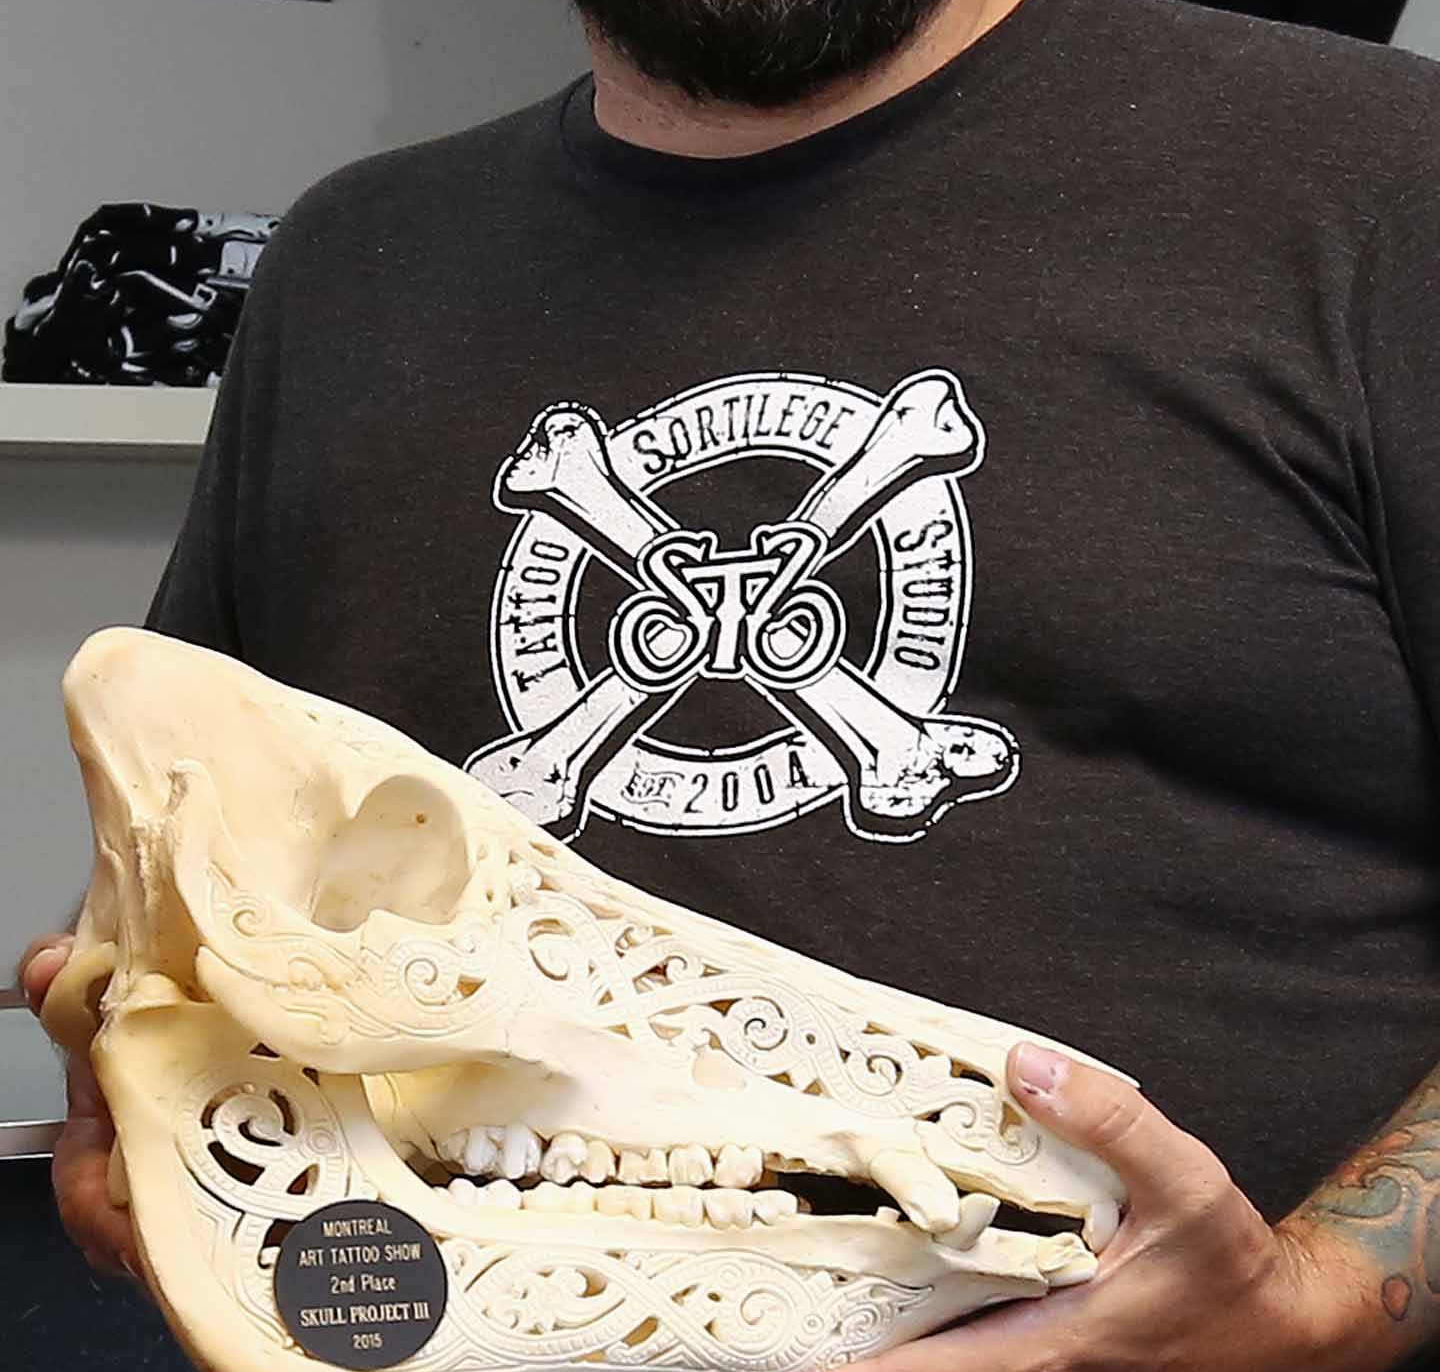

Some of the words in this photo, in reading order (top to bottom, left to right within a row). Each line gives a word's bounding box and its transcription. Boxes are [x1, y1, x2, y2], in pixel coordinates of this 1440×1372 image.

[632, 393, 857, 476] SORTILEGE
[893, 509, 955, 672] STUDIO
[512, 537, 570, 692] TATTOO
[323, 1219, 392, 1237] MONTREAL
[299, 1249, 324, 1267] ART
[330, 1246, 380, 1265] TATTOO
[385, 1243, 422, 1262] SHOW
[330, 1276, 355, 1294] 2nd
[361, 1274, 397, 1293] Place
[300, 1306, 347, 1327] SKULL
[350, 1303, 410, 1325] PROJECT
[413, 1301, 431, 1321] III
[353, 1332, 383, 1350] 2015
